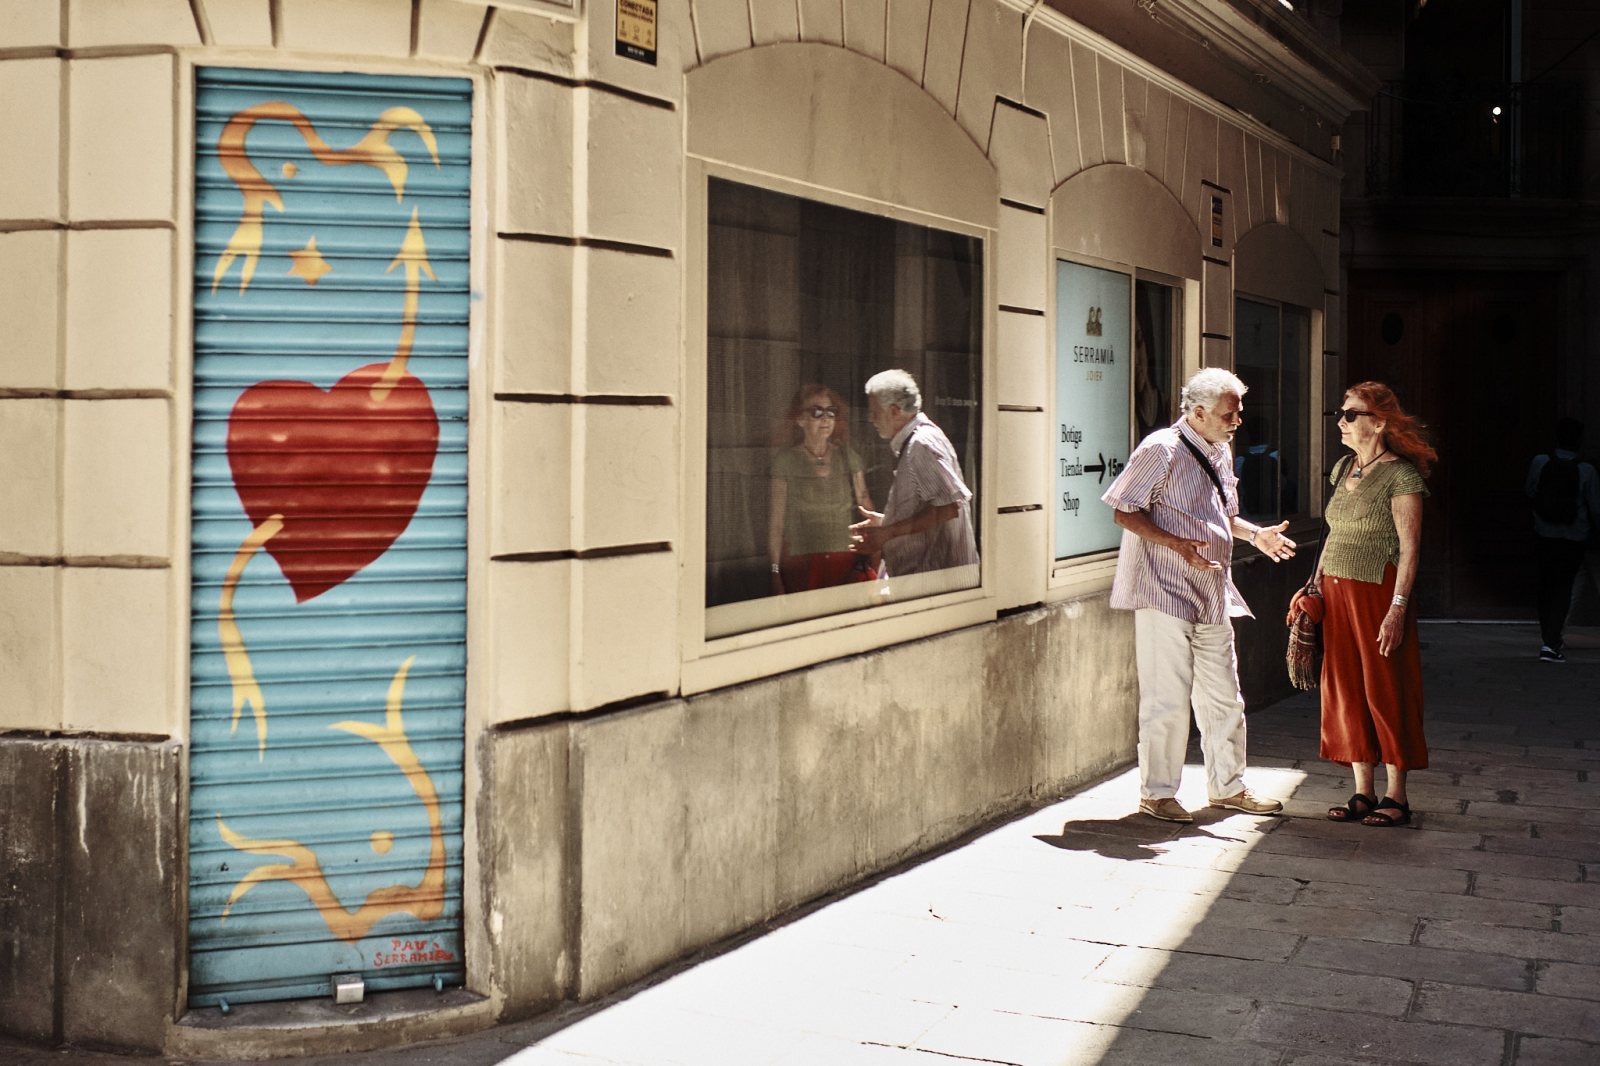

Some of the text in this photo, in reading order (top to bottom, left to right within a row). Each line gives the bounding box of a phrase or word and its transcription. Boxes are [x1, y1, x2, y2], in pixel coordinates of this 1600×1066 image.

[1061, 424, 1082, 449] Botiga
[1060, 457, 1082, 477] Tienda
[1063, 492, 1080, 516] Shop
